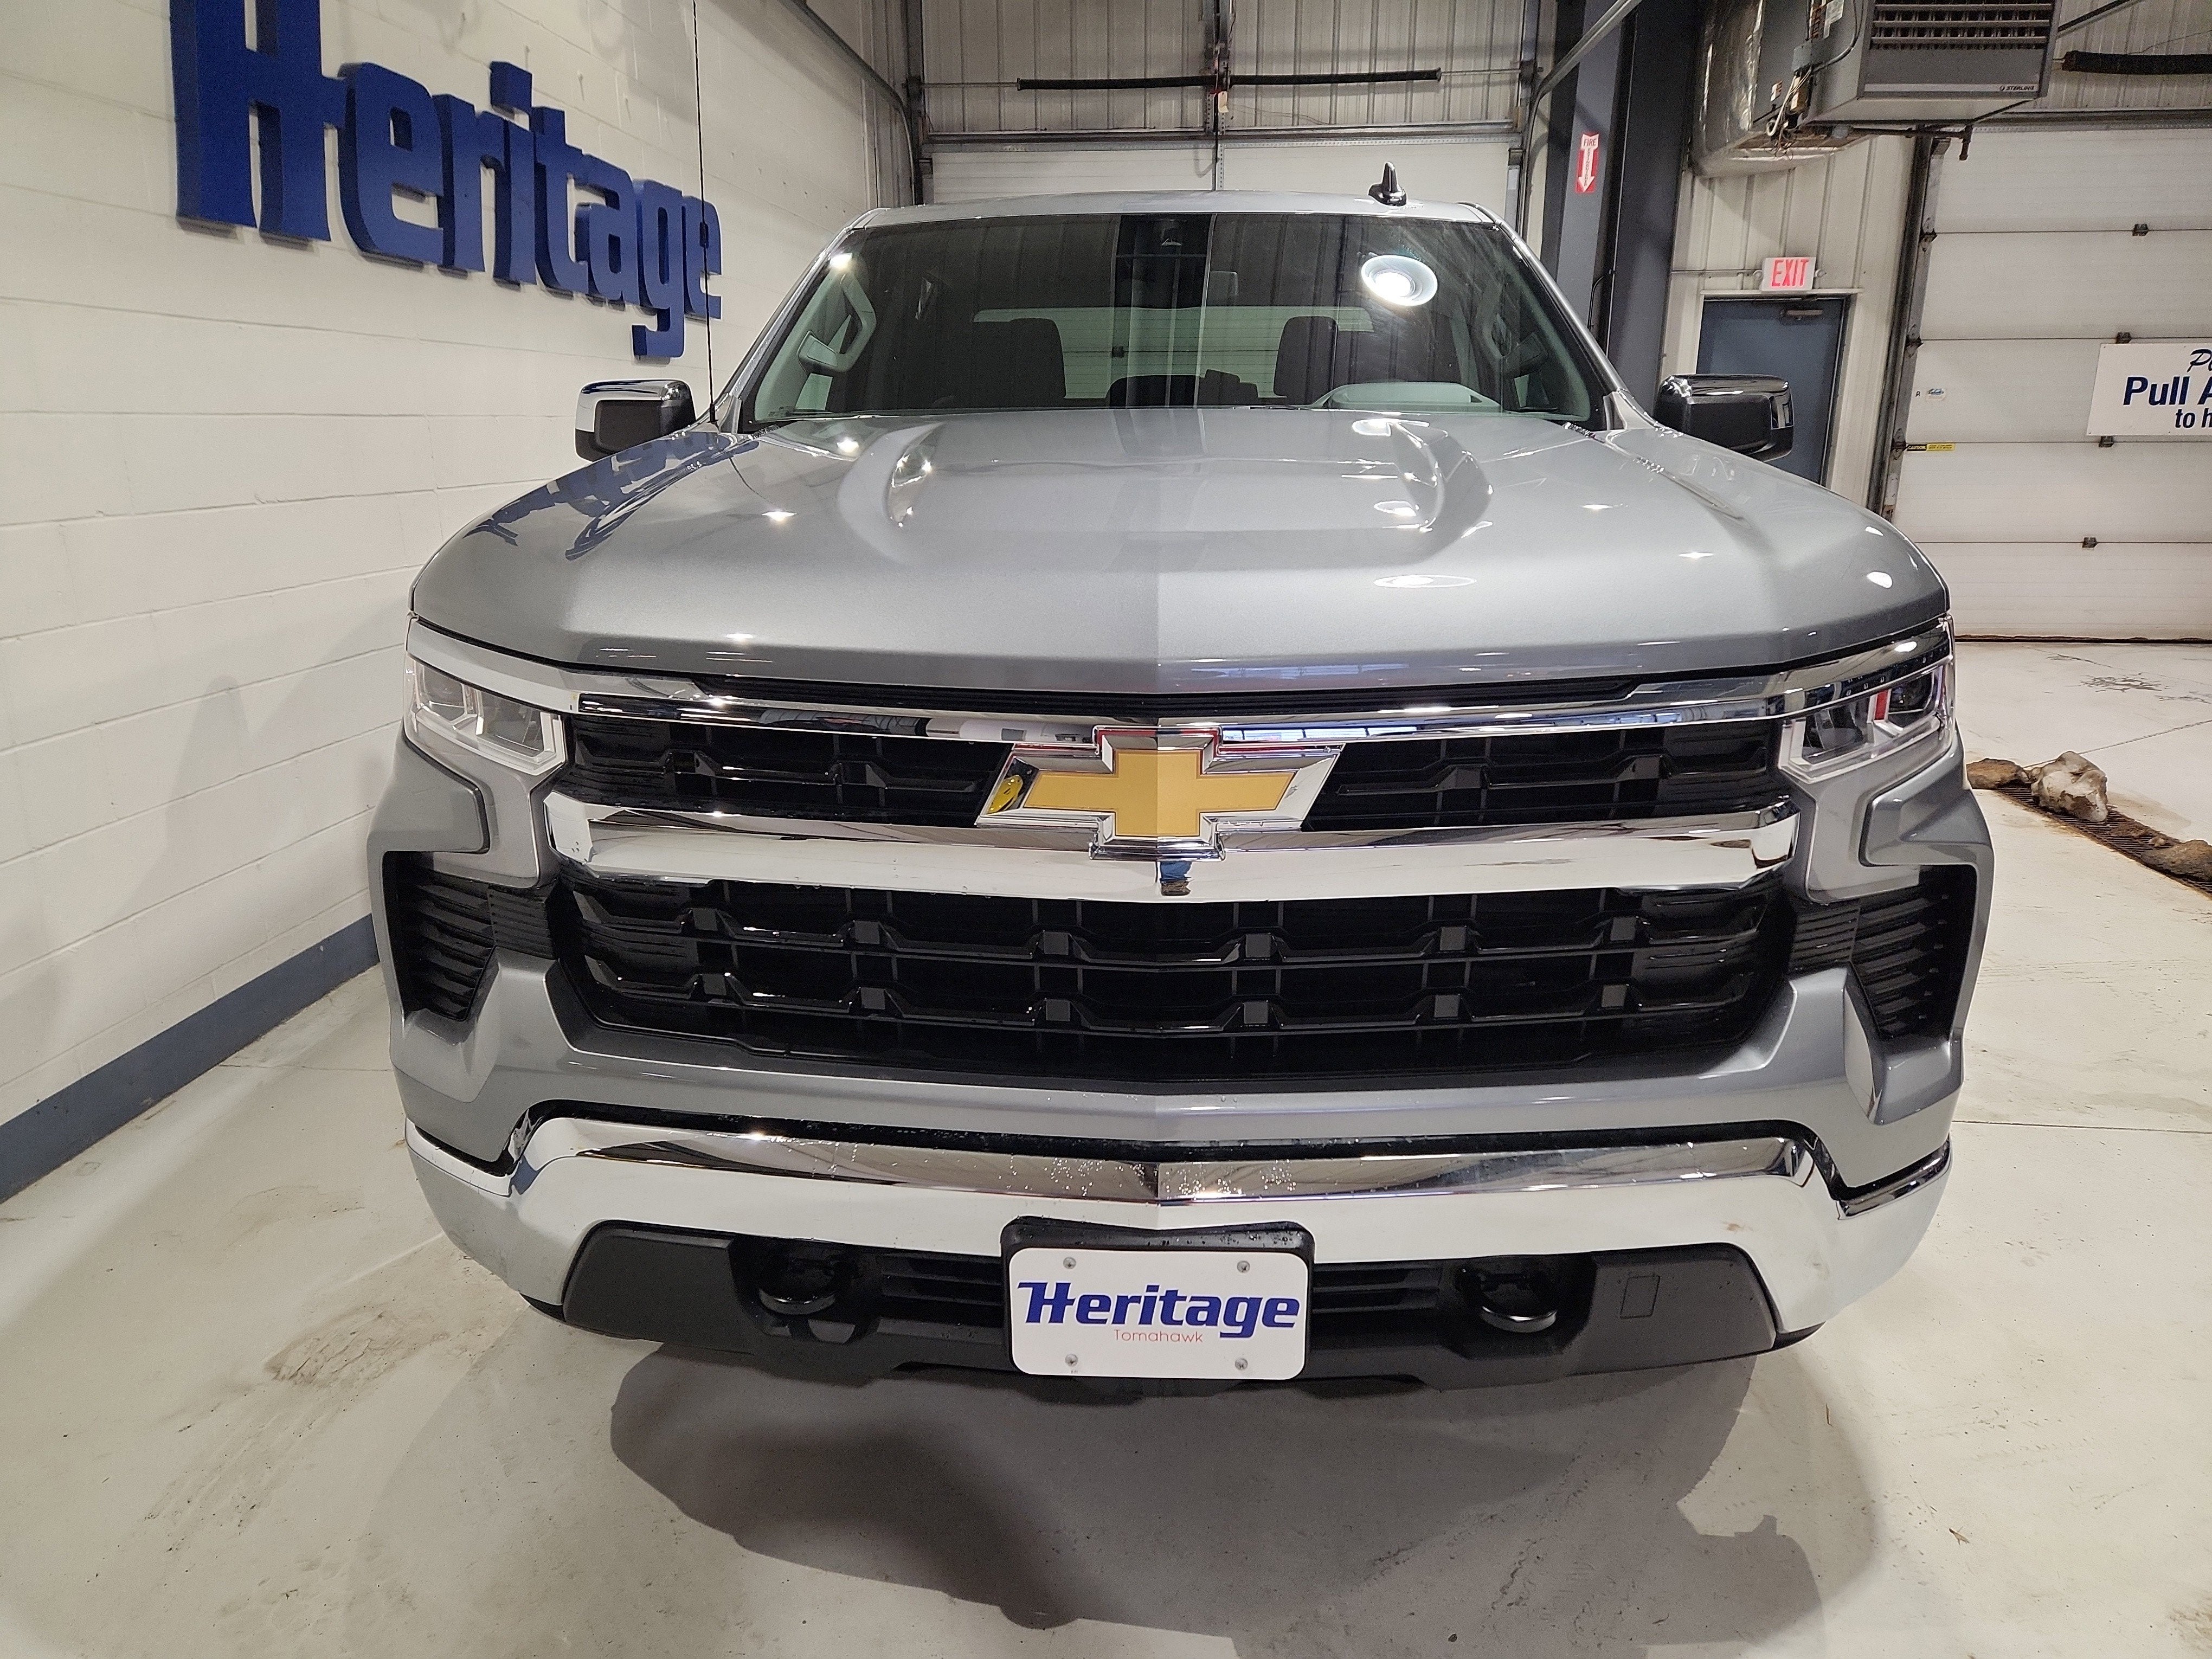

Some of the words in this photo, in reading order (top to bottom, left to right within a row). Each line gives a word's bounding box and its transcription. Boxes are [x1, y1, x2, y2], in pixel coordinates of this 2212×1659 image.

[1584, 138, 1597, 146] FIRE
[169, 0, 722, 357] Heritage
[1771, 259, 1809, 286] EXIT
[2123, 376, 2190, 406] Pull
[2175, 409, 2196, 428] to
[1017, 1282, 1300, 1338] Heritage
[1114, 1329, 1203, 1343] Tomahawk
